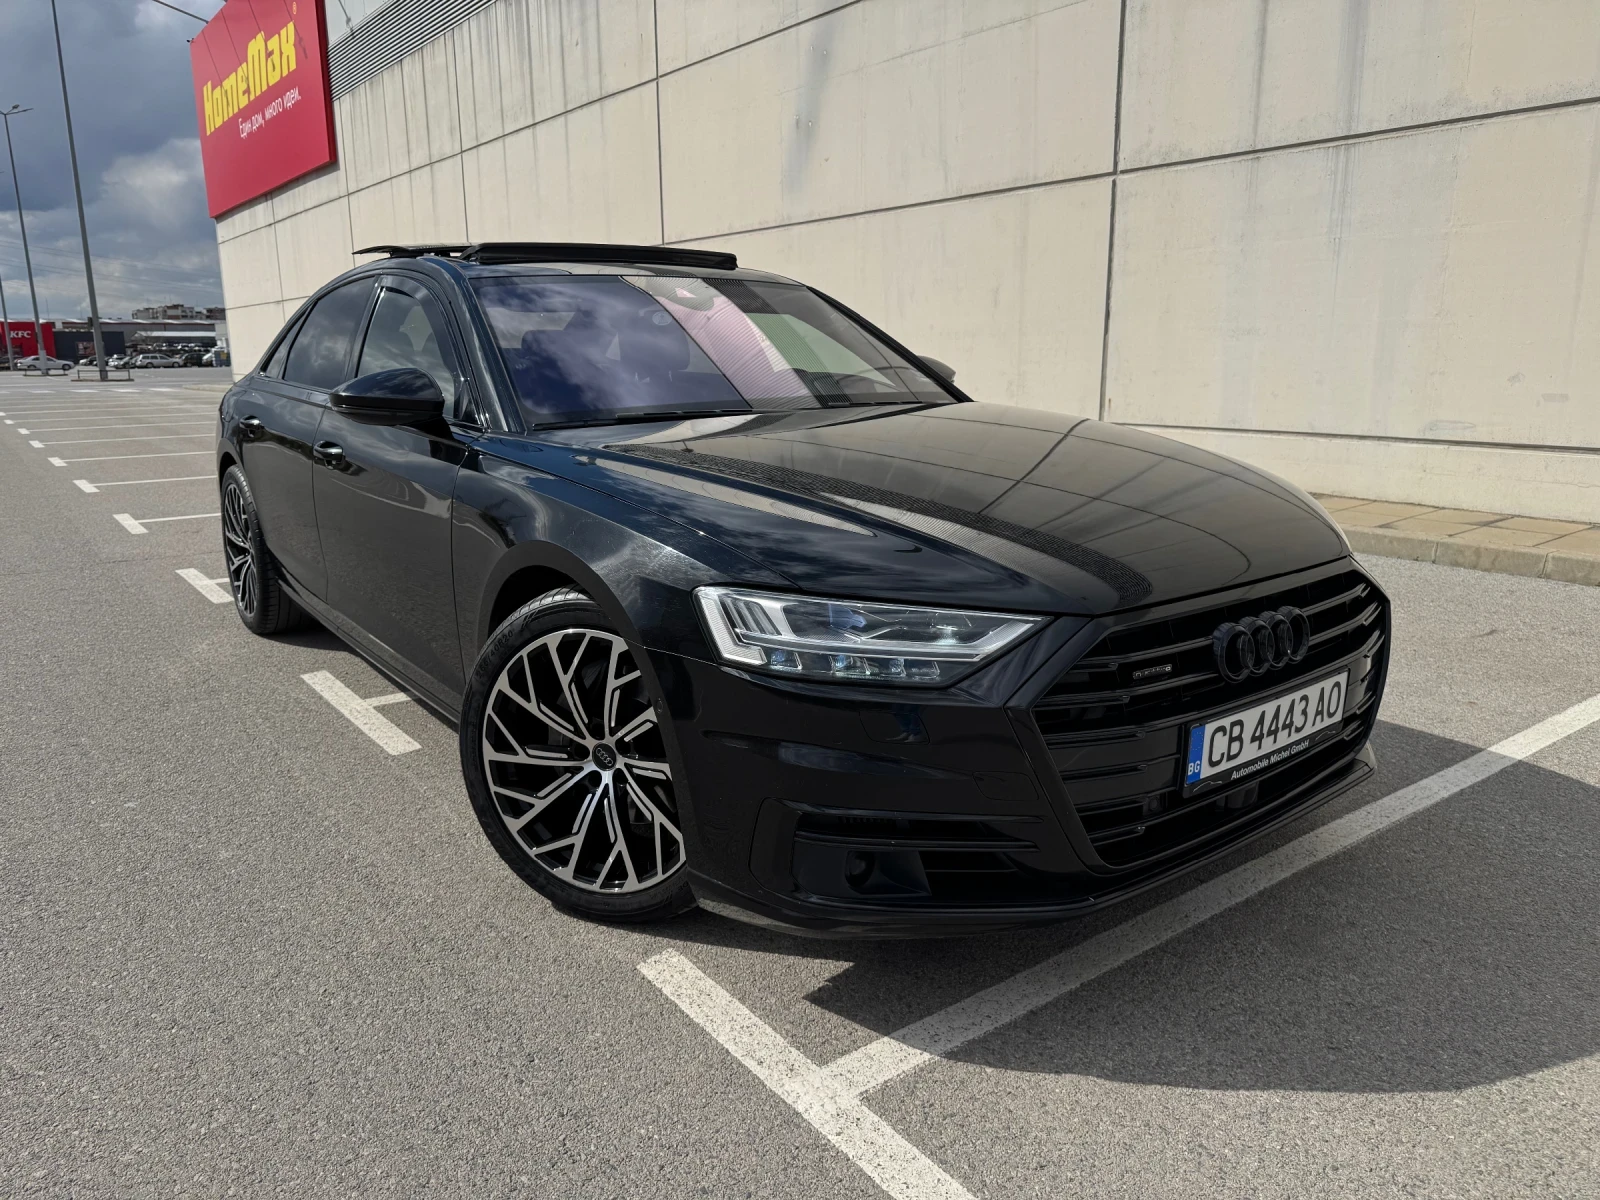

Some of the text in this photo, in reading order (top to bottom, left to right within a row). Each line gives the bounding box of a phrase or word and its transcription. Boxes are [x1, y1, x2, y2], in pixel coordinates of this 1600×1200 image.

[203, 20, 297, 136] HomeMax
[238, 85, 301, 139] Един дом, много идеи.
[10, 330, 31, 338] KFC
[1207, 681, 1342, 768] CB 4443 AO
[1187, 760, 1201, 776] BG
[1231, 739, 1310, 780] Automobile Michel GmbH
